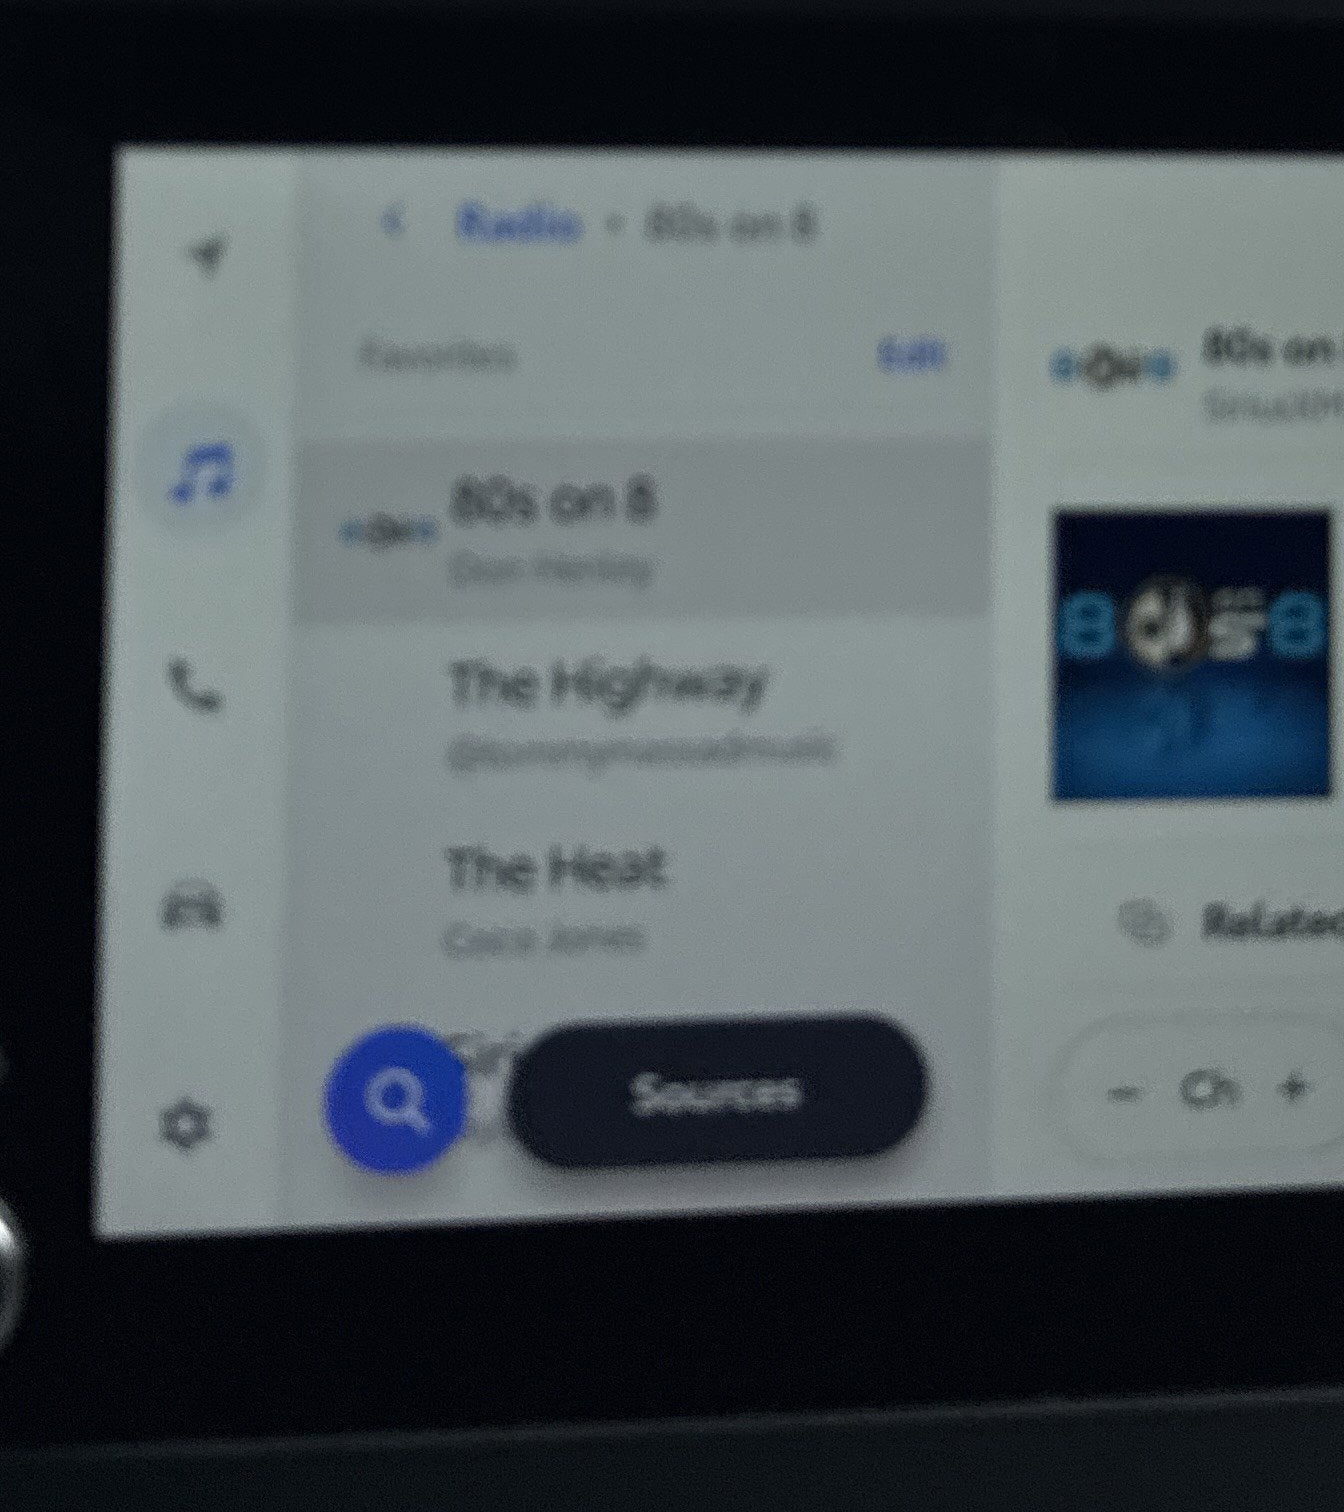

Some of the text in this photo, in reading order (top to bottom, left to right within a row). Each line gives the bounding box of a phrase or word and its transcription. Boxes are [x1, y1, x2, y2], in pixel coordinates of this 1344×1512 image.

[458, 202, 583, 245] Radio
[646, 203, 718, 244] 80s
[730, 212, 783, 243] on
[878, 336, 948, 372] Edit
[1204, 327, 1272, 366] 80s
[1283, 336, 1333, 365] on
[451, 473, 657, 526] 80s on 8
[449, 657, 769, 718] The Highway
[445, 845, 668, 893] The Heat
[630, 1072, 803, 1118] Sources
[1180, 1067, 1240, 1109] Ch
